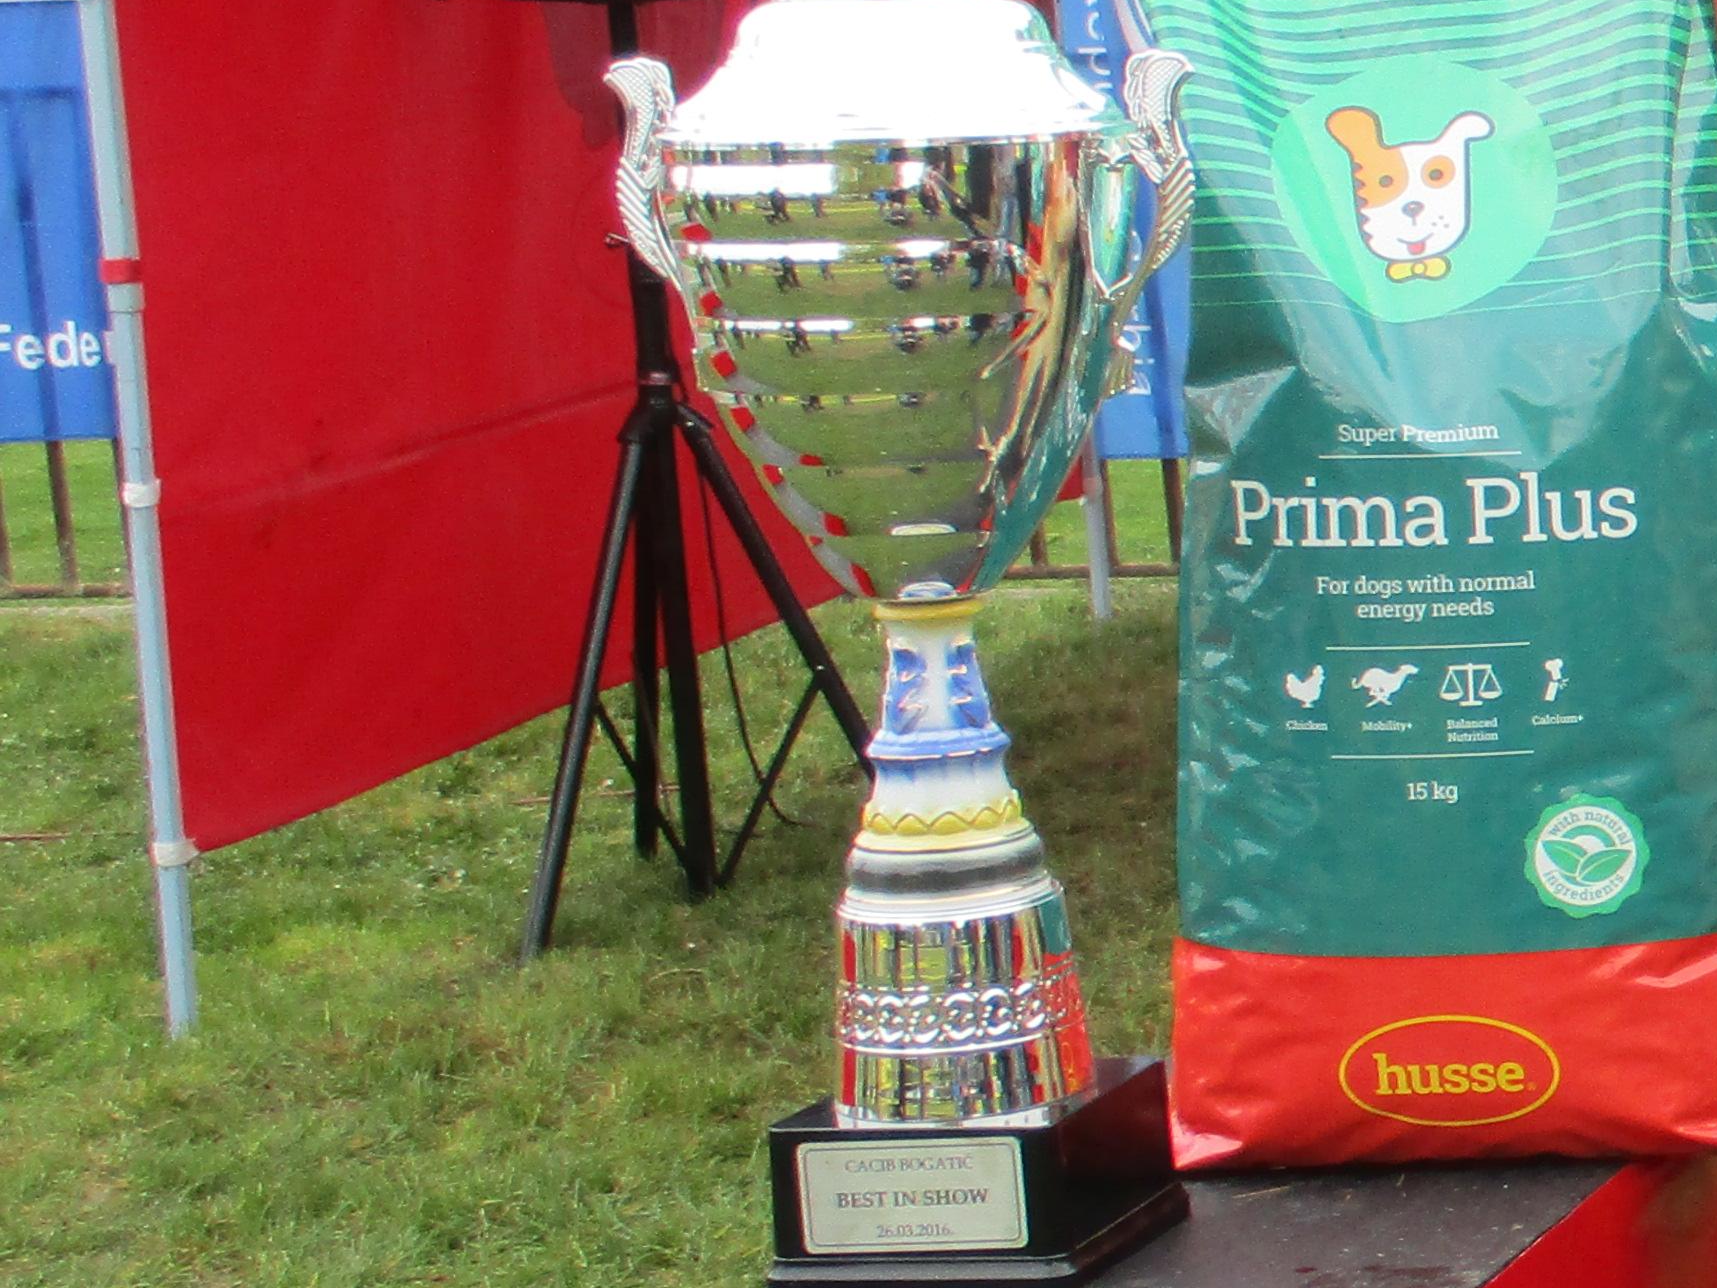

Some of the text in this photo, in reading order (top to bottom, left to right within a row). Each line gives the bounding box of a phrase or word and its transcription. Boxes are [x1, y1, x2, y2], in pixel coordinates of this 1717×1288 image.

[1338, 421, 1499, 447] Super Premium
[1231, 471, 1638, 548] Prima Plus
[1317, 571, 1536, 598] For dogs with normal
[1357, 597, 1494, 622] energy needs
[1407, 780, 1459, 803] 15 kg
[1548, 806, 1631, 848] with natural
[1543, 867, 1626, 902] ingredients
[1373, 1052, 1525, 1095] husse
[845, 1156, 896, 1173] CACIB
[837, 1188, 989, 1209] BEST IN SHOW
